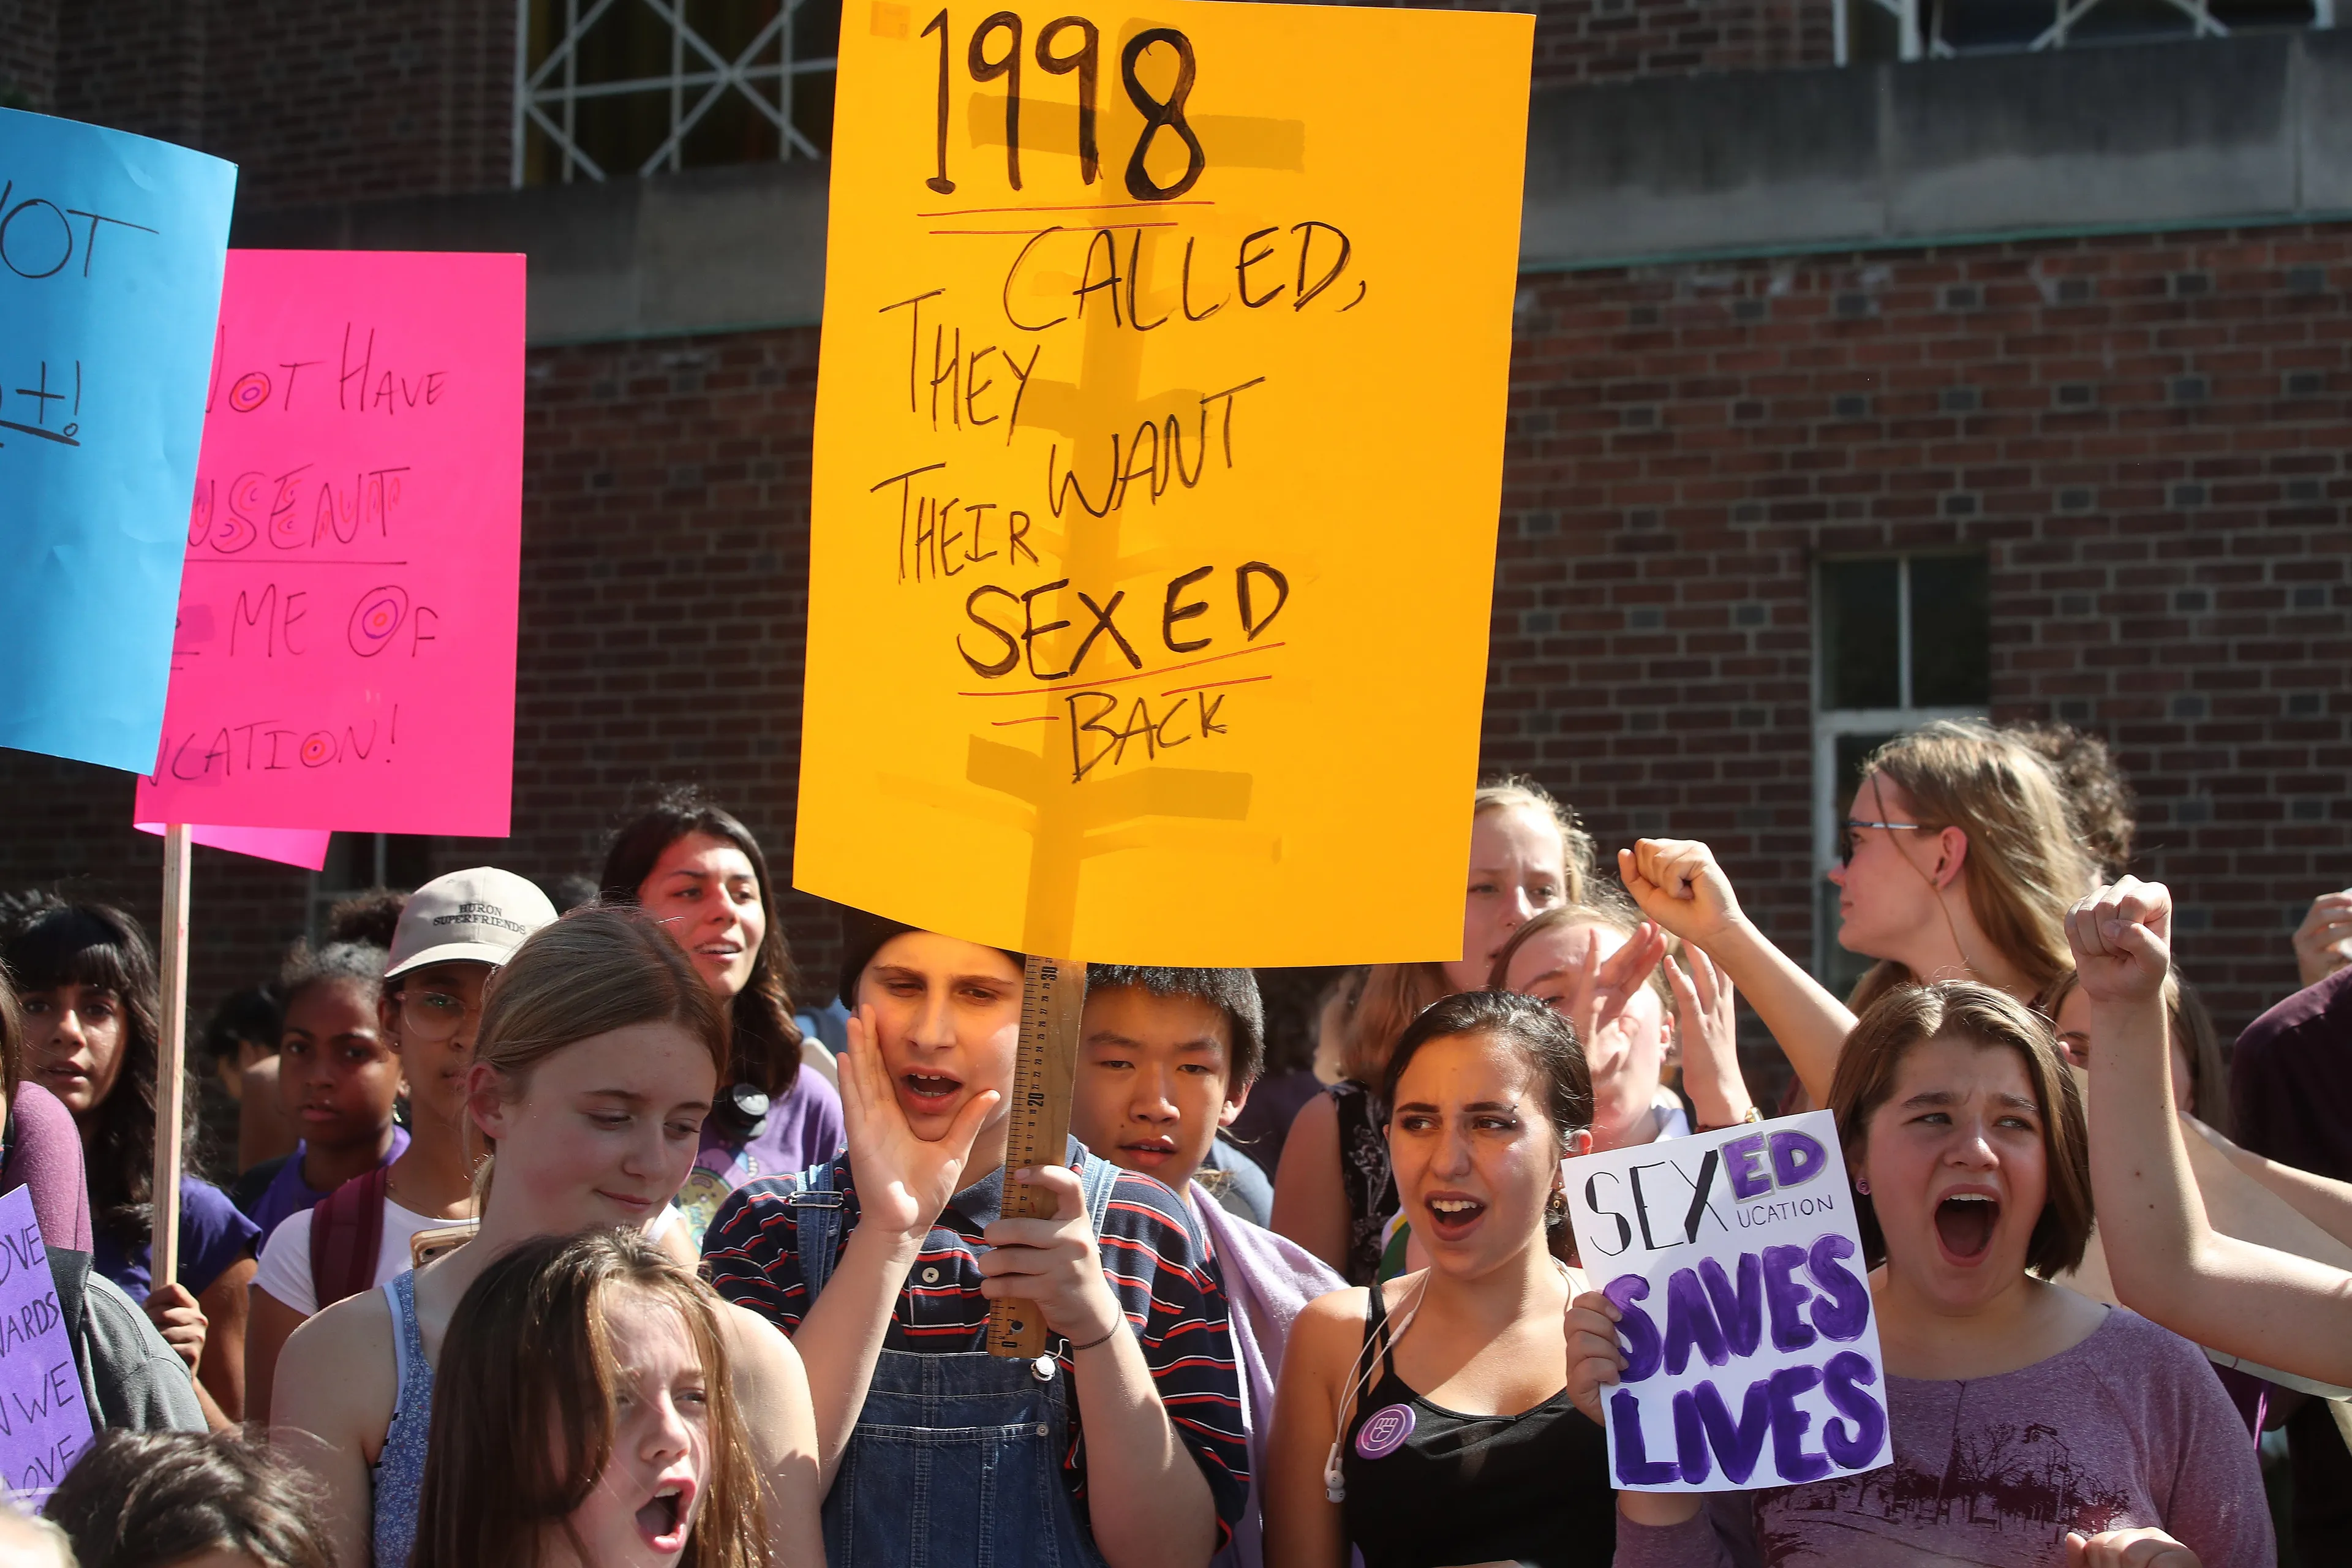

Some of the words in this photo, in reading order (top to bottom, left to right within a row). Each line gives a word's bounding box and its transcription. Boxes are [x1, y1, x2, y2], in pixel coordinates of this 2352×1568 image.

[921, 9, 1205, 201] 1998
[0, 179, 159, 278] OT
[1004, 221, 1366, 331] CALLED,
[340, 322, 450, 415] HAVE
[880, 288, 1041, 446] THEY
[1049, 377, 1265, 518] WANT
[870, 463, 1039, 584] THEIR
[230, 584, 307, 658] ME
[347, 586, 439, 658] OF
[1066, 691, 1227, 784] BACK
[433, 914, 526, 935] SUPERFRIENDS
[459, 903, 502, 917] HURON
[1027, 1092, 1045, 1107] 20
[1736, 1194, 1833, 1228] UCATION
[1602, 1231, 1871, 1384] SAVES
[12, 1361, 74, 1423] WE
[1610, 1349, 1888, 1486] LIVES
